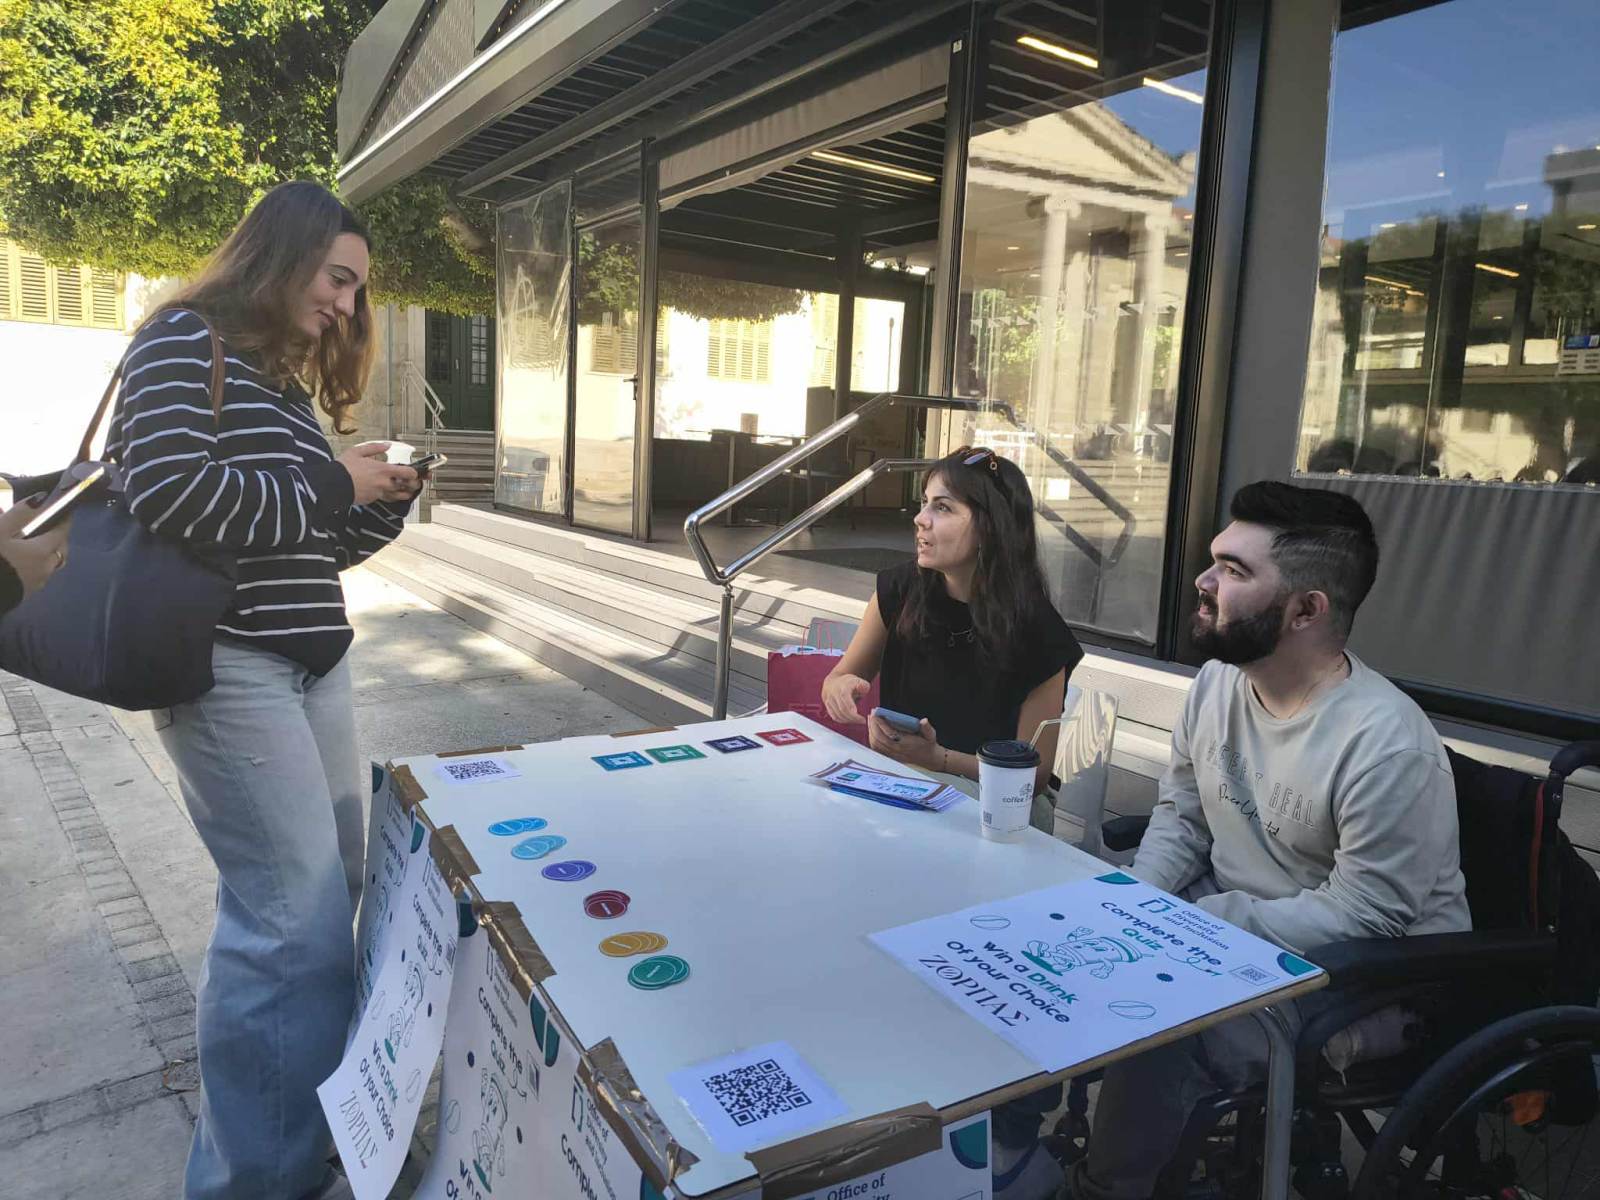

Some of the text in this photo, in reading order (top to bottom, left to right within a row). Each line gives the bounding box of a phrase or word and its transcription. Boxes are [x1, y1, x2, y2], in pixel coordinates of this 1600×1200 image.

[1100, 902, 1222, 966] Complete the
[1121, 927, 1165, 951] Quiz
[1162, 915, 1230, 950] and Inclusion
[1172, 913, 1218, 936] Diversity
[1181, 910, 1225, 931] Office of
[946, 940, 1071, 1024] Of your Choice
[983, 941, 1080, 1004] Win a Drink
[478, 986, 508, 1050] Complete
[509, 1040, 523, 1075] the
[360, 1057, 395, 1141] Of your Choice
[827, 1184, 869, 1200] Office
[871, 1172, 886, 1190] of
